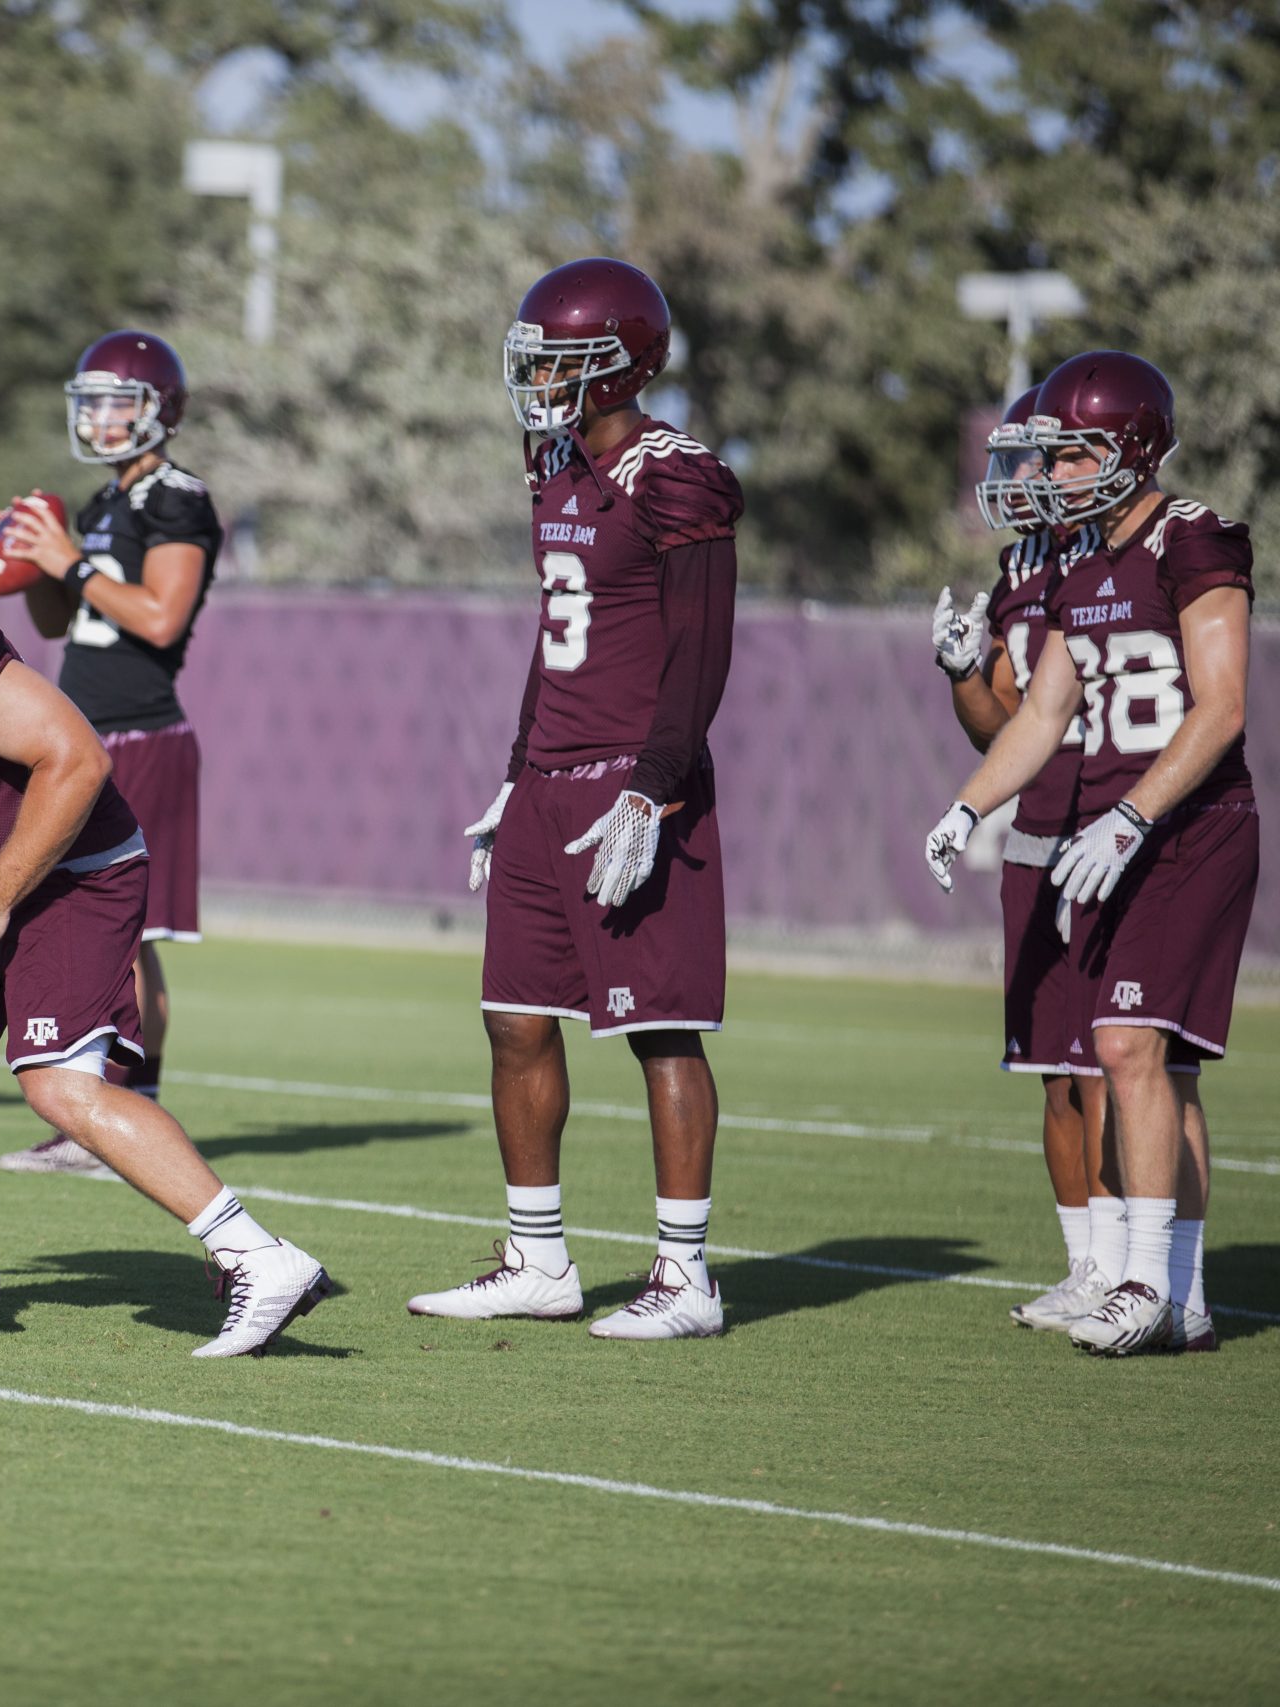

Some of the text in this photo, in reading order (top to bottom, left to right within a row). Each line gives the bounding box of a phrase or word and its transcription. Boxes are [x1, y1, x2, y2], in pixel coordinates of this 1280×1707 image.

[540, 522, 596, 546] TEXAS A&M
[541, 551, 594, 671] 3
[1070, 605, 1108, 626] TEXAS
[1109, 600, 1132, 621] A&M
